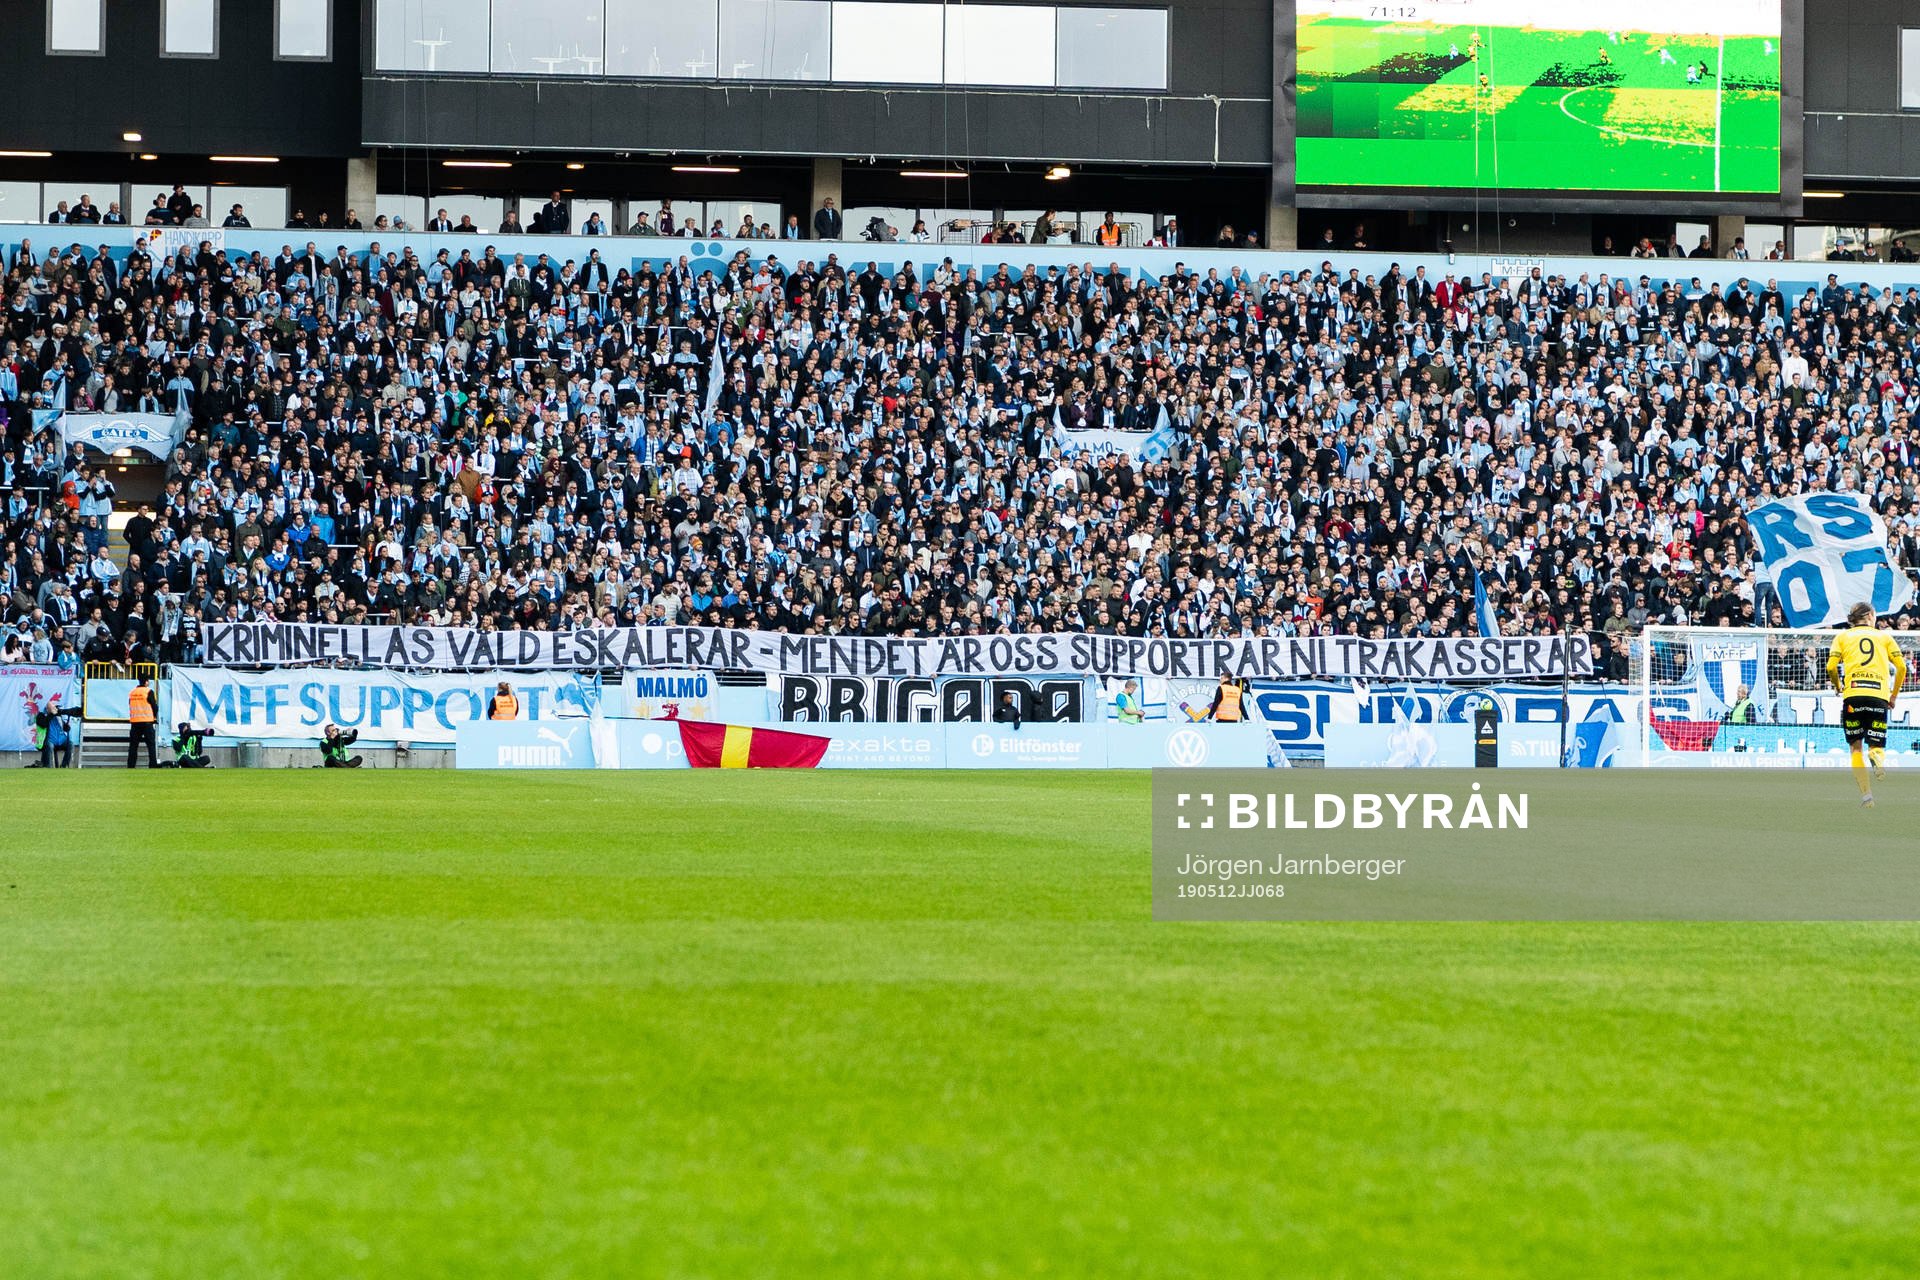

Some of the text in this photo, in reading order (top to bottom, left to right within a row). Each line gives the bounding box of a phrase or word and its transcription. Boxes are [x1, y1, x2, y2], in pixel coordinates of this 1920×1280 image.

[1369, 6, 1416, 17] 71:12
[164, 230, 222, 248] HANDIKAPP
[1745, 495, 1873, 568] RS
[207, 623, 435, 665] KRIMINELLAS
[446, 628, 541, 666] VÅLD
[553, 628, 754, 668] ESKALERAR
[779, 635, 858, 675] MEN
[865, 638, 928, 675] DET
[936, 638, 985, 673] ÄR
[989, 636, 1058, 672] OSS
[1070, 634, 1285, 677] SUPPORTRAR
[1290, 638, 1327, 675] NI
[1335, 637, 1592, 677] TRAKASSERAR
[1859, 637, 1875, 667] 9
[636, 673, 708, 698] MALMÖ
[189, 682, 289, 726] MFF
[498, 745, 561, 766] PUMA
[830, 736, 931, 753] exakta
[1000, 738, 1082, 753] Elitfönster
